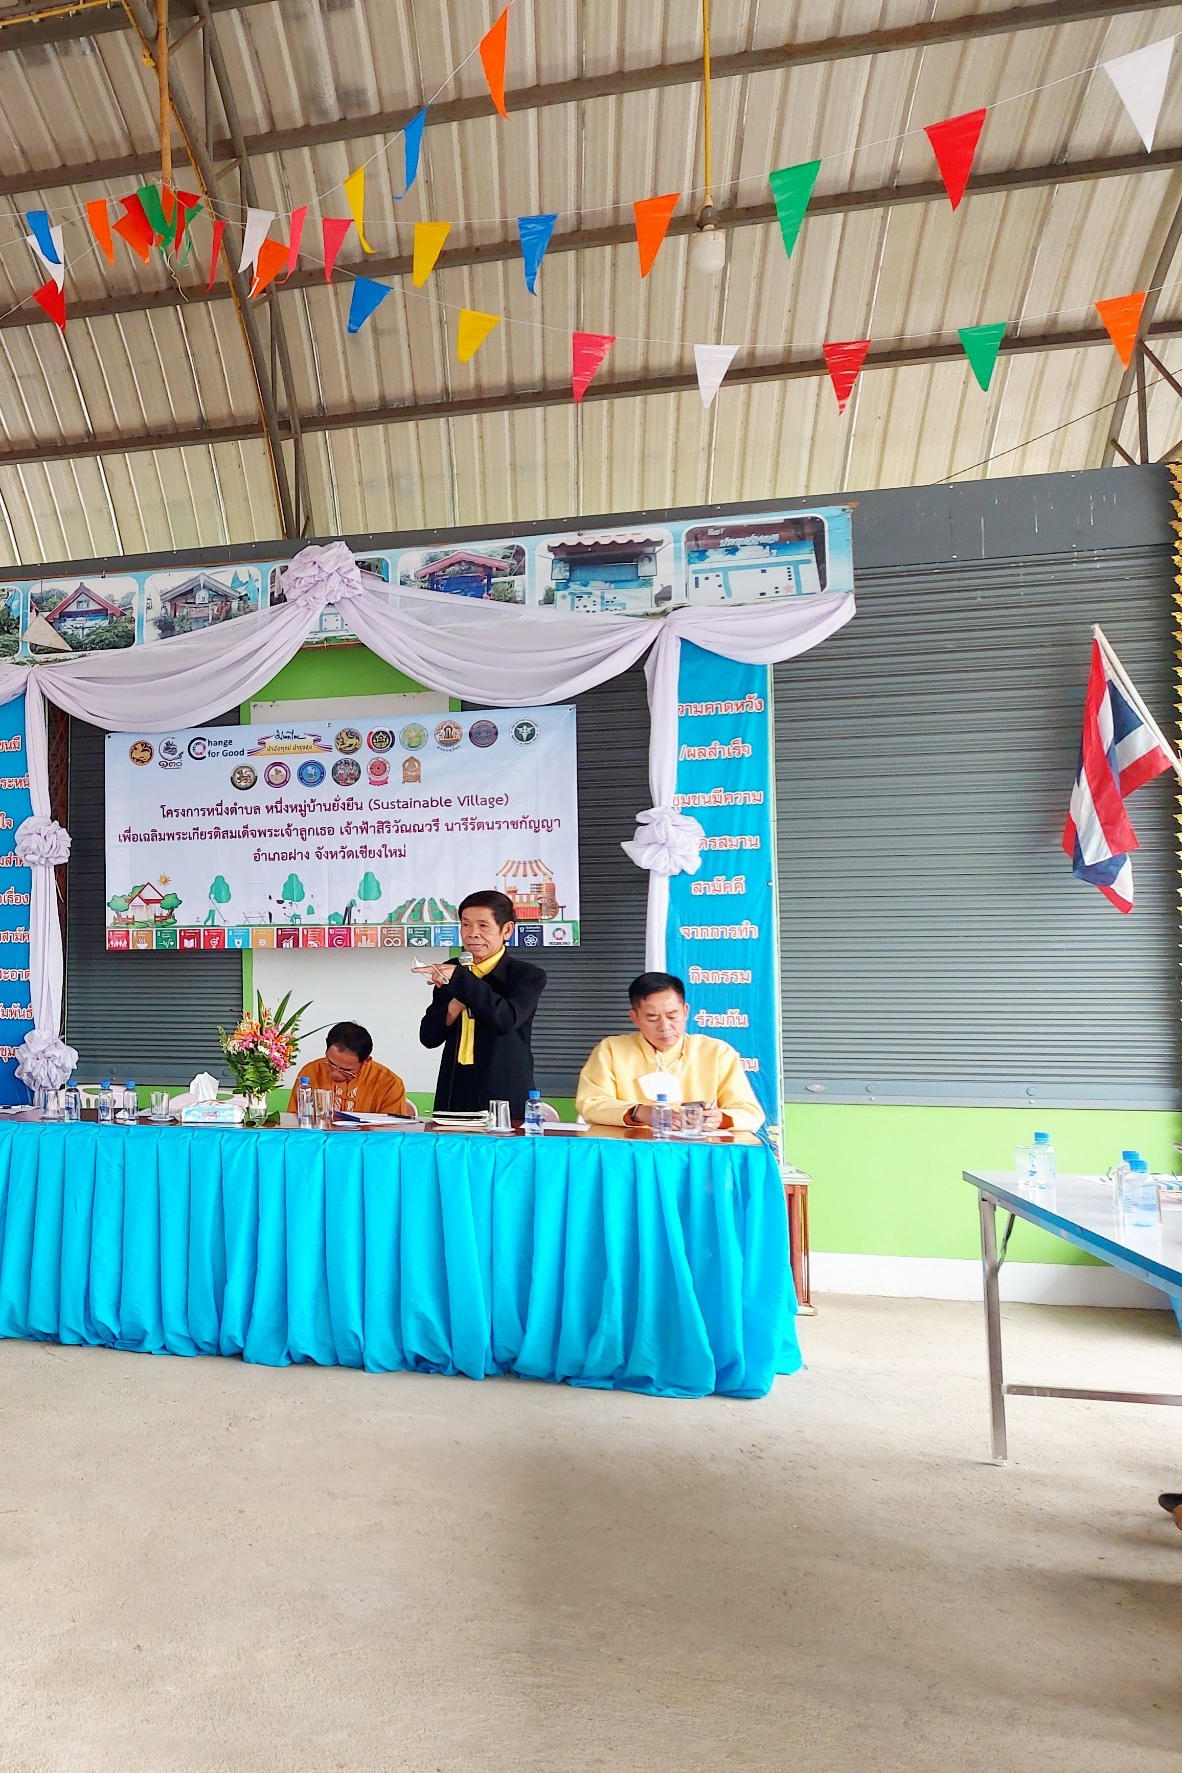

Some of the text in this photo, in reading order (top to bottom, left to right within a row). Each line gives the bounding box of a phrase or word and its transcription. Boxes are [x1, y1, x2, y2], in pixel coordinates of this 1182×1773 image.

[678, 694, 764, 716] วามคาดหวัง
[207, 748, 245, 758] for Good
[679, 738, 751, 760] /ผลสำเร็จ
[160, 793, 509, 819] โครงการหนึ่งตำบล หนึ่งหมู่บ้านยั่งยืน (Sustainable Village)
[118, 814, 561, 843] เพื่อเฉลิมพระเกียรติสมเด็จพระเจ้าลูกเธอ เจ้าฟ้าสิริวัณณวรี นารีรัตนราชกัญญา
[253, 844, 407, 862] อำเภอฝาง จังหวัดเชียงใหม่
[692, 876, 745, 895] สามัคคี
[681, 921, 758, 939] จากการทำ
[690, 967, 751, 984] กิจกรรม
[696, 1010, 748, 1027] ร่วมกัน
